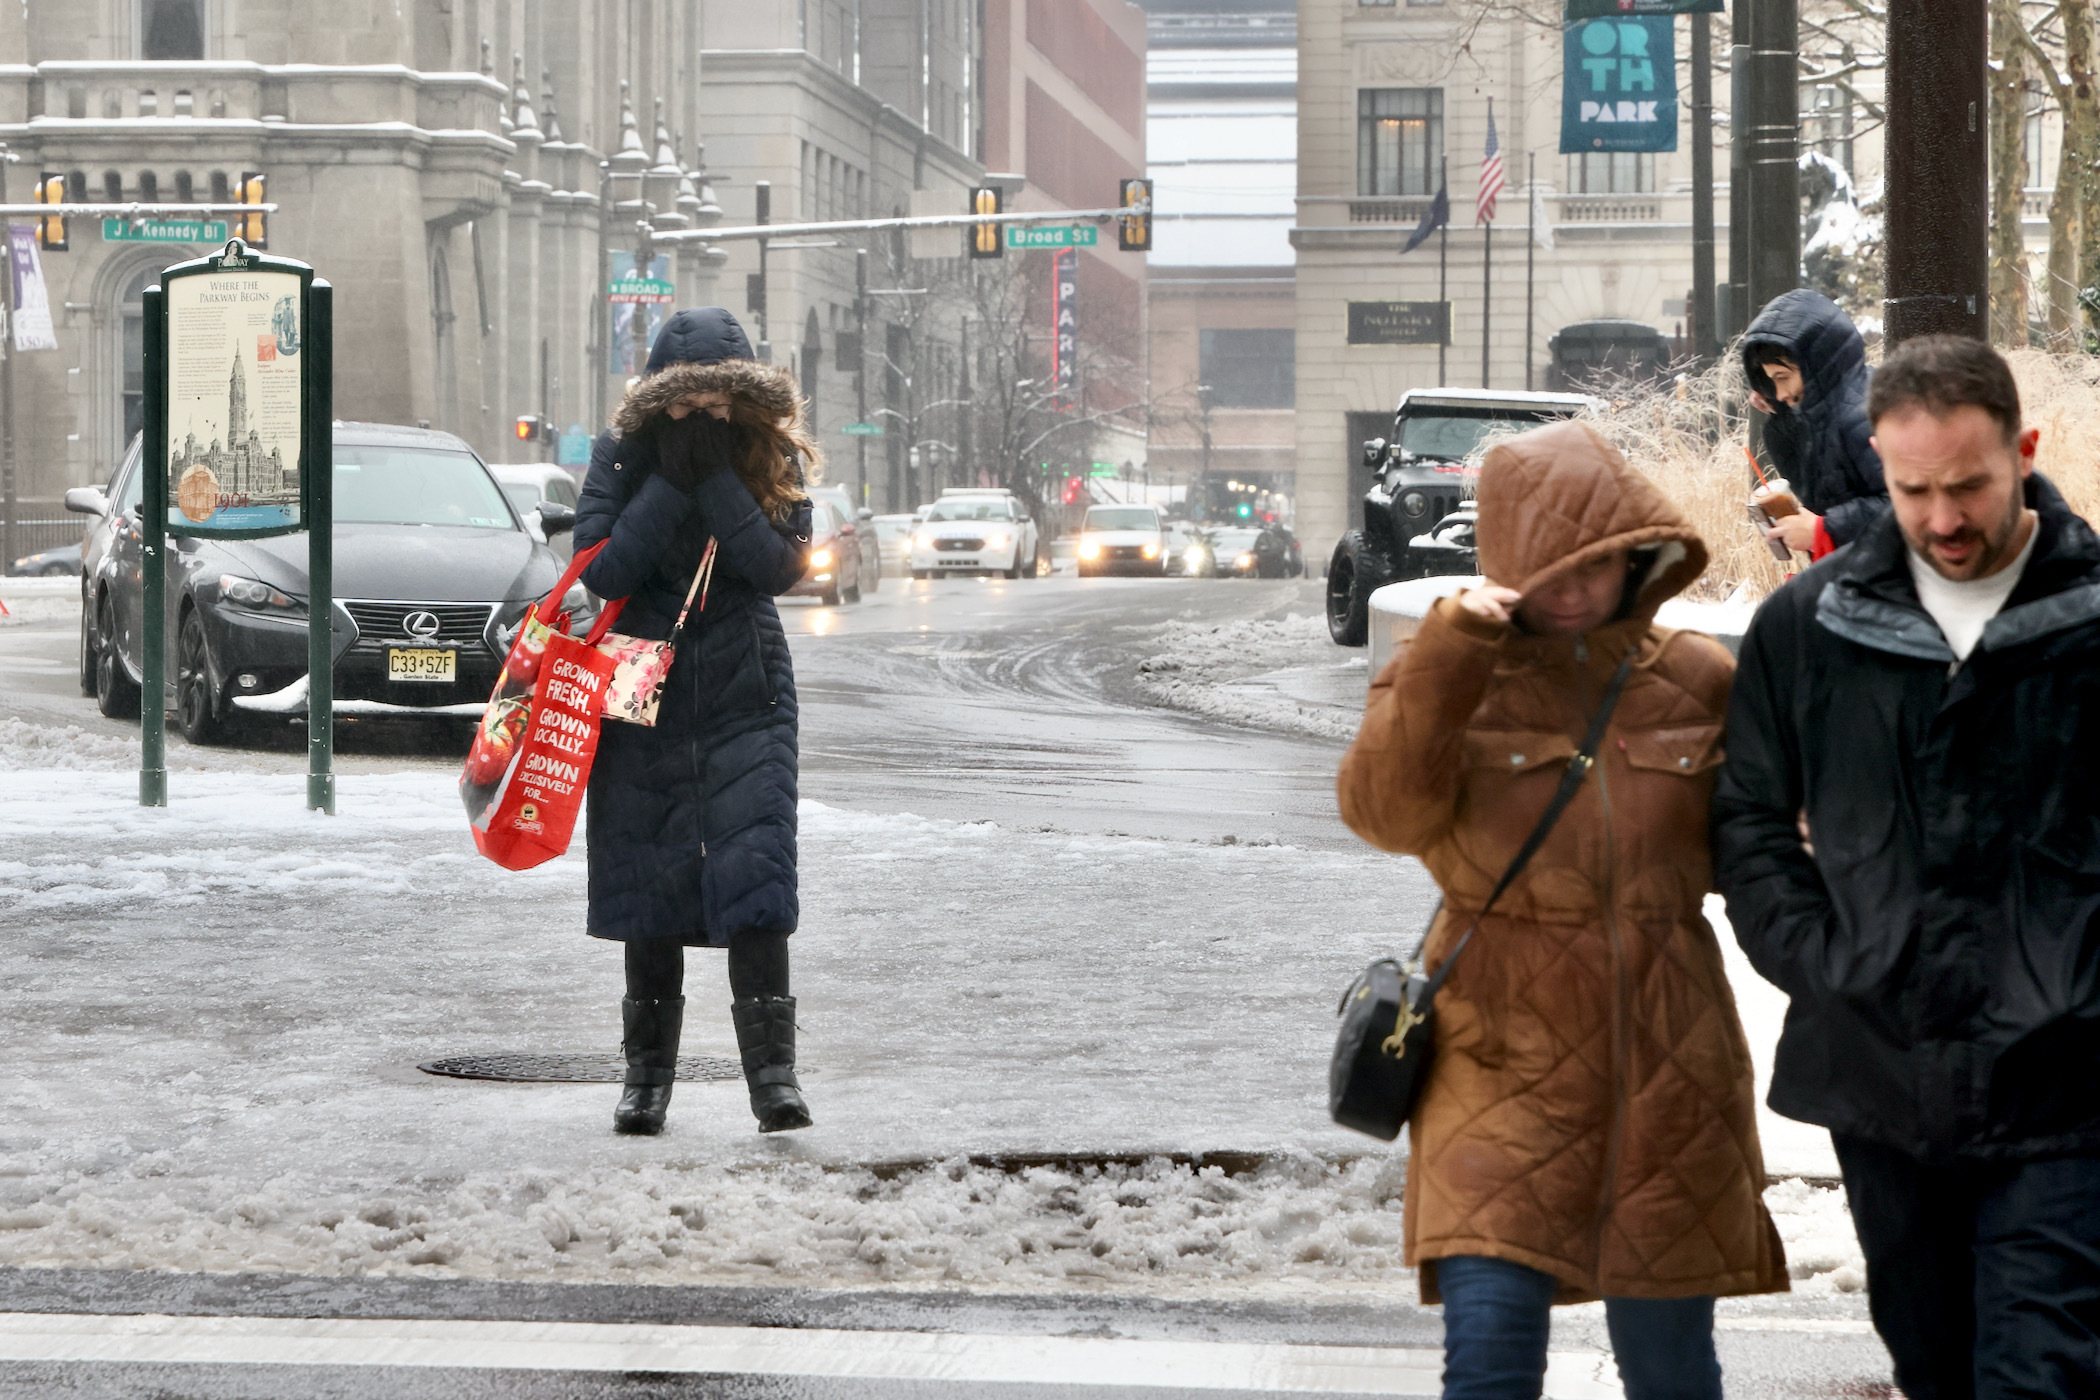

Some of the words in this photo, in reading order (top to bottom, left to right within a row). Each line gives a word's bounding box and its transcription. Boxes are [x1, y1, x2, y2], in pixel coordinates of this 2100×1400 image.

[1582, 21, 1649, 57] OR
[1582, 58, 1655, 92] TH
[1580, 101, 1658, 122] PARK
[143, 223, 198, 241] Kennedy
[1015, 230, 1063, 244] Broad
[1072, 229, 1090, 243] St
[210, 281, 239, 291] WHERE
[243, 281, 258, 290] THE
[620, 284, 660, 294] BROAD
[200, 293, 237, 303] PARKWAY
[240, 292, 269, 301] BEGINS
[214, 492, 249, 512] 1901
[391, 655, 417, 673] C33
[552, 658, 600, 692] GROWN
[545, 679, 591, 716] FRESH.
[539, 708, 591, 739] GROWN
[525, 752, 580, 783] GROWN
